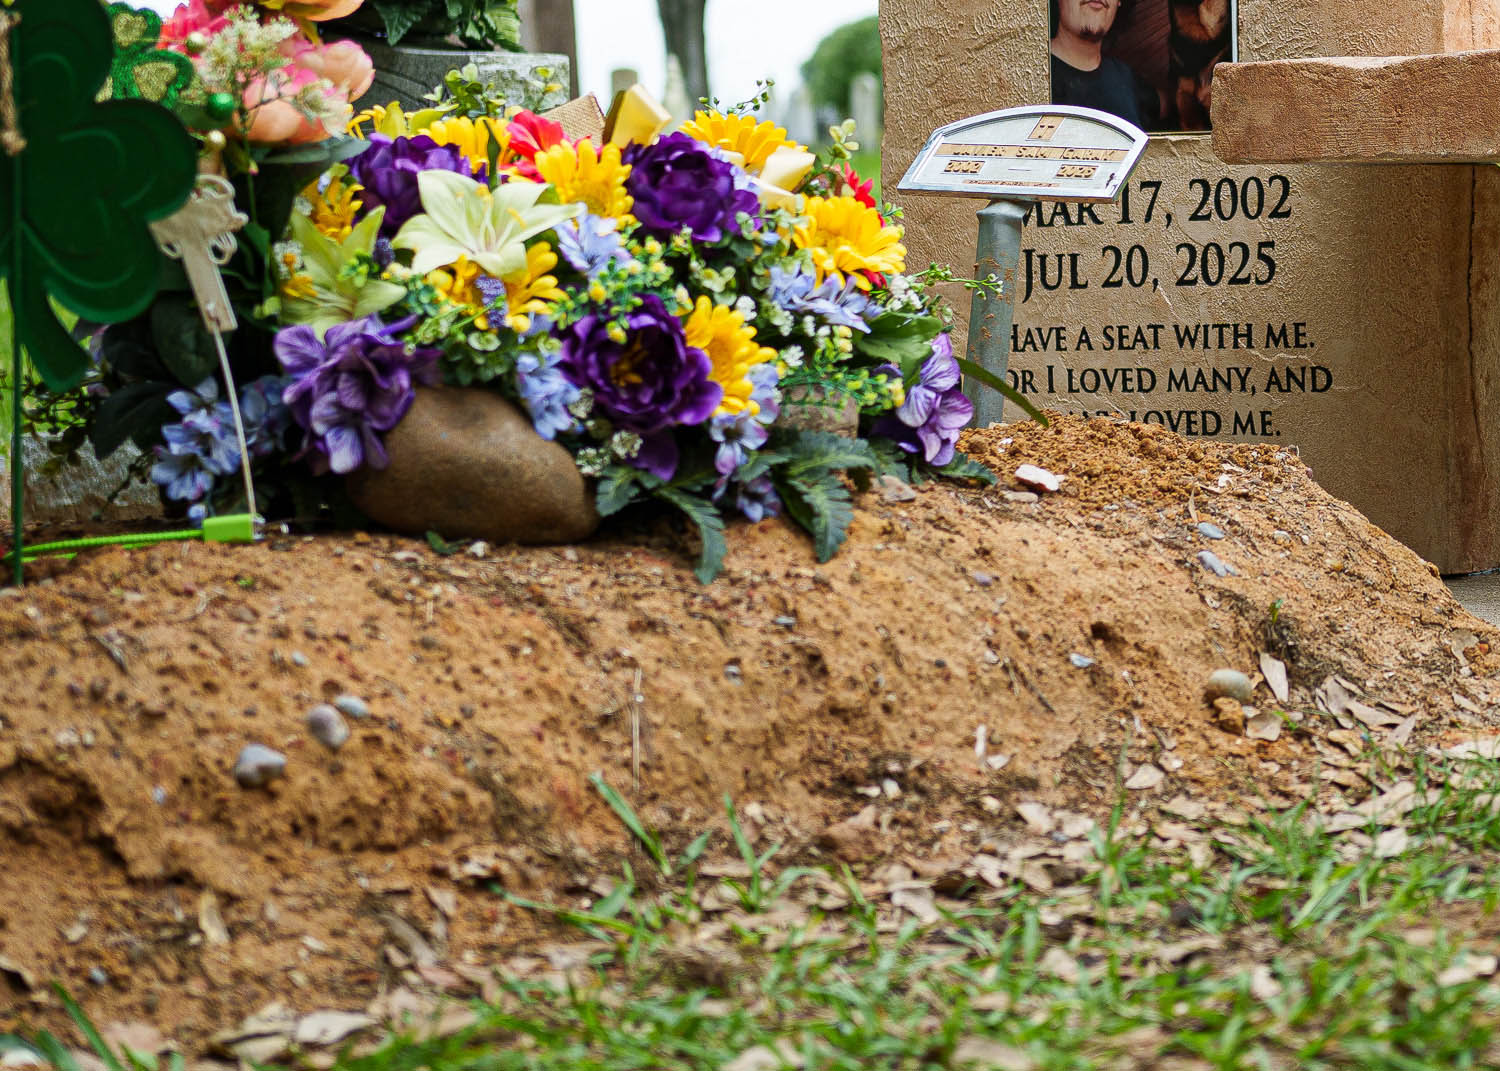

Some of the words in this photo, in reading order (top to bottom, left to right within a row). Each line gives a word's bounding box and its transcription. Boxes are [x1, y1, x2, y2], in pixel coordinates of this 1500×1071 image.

[1117, 180, 1172, 229] 17,
[1188, 175, 1292, 222] 2002
[1022, 248, 1088, 304] JUL
[1101, 244, 1159, 293] 20,
[1175, 240, 1276, 286] 2025
[1076, 326, 1093, 351] A
[1103, 324, 1164, 350] SEAT
[1173, 322, 1253, 349] WITH
[1265, 321, 1315, 349] ME.
[1067, 368, 1157, 394] LOVED
[1167, 367, 1256, 396] MANY,
[1266, 365, 1332, 393] AND
[1232, 409, 1281, 436] ME.
